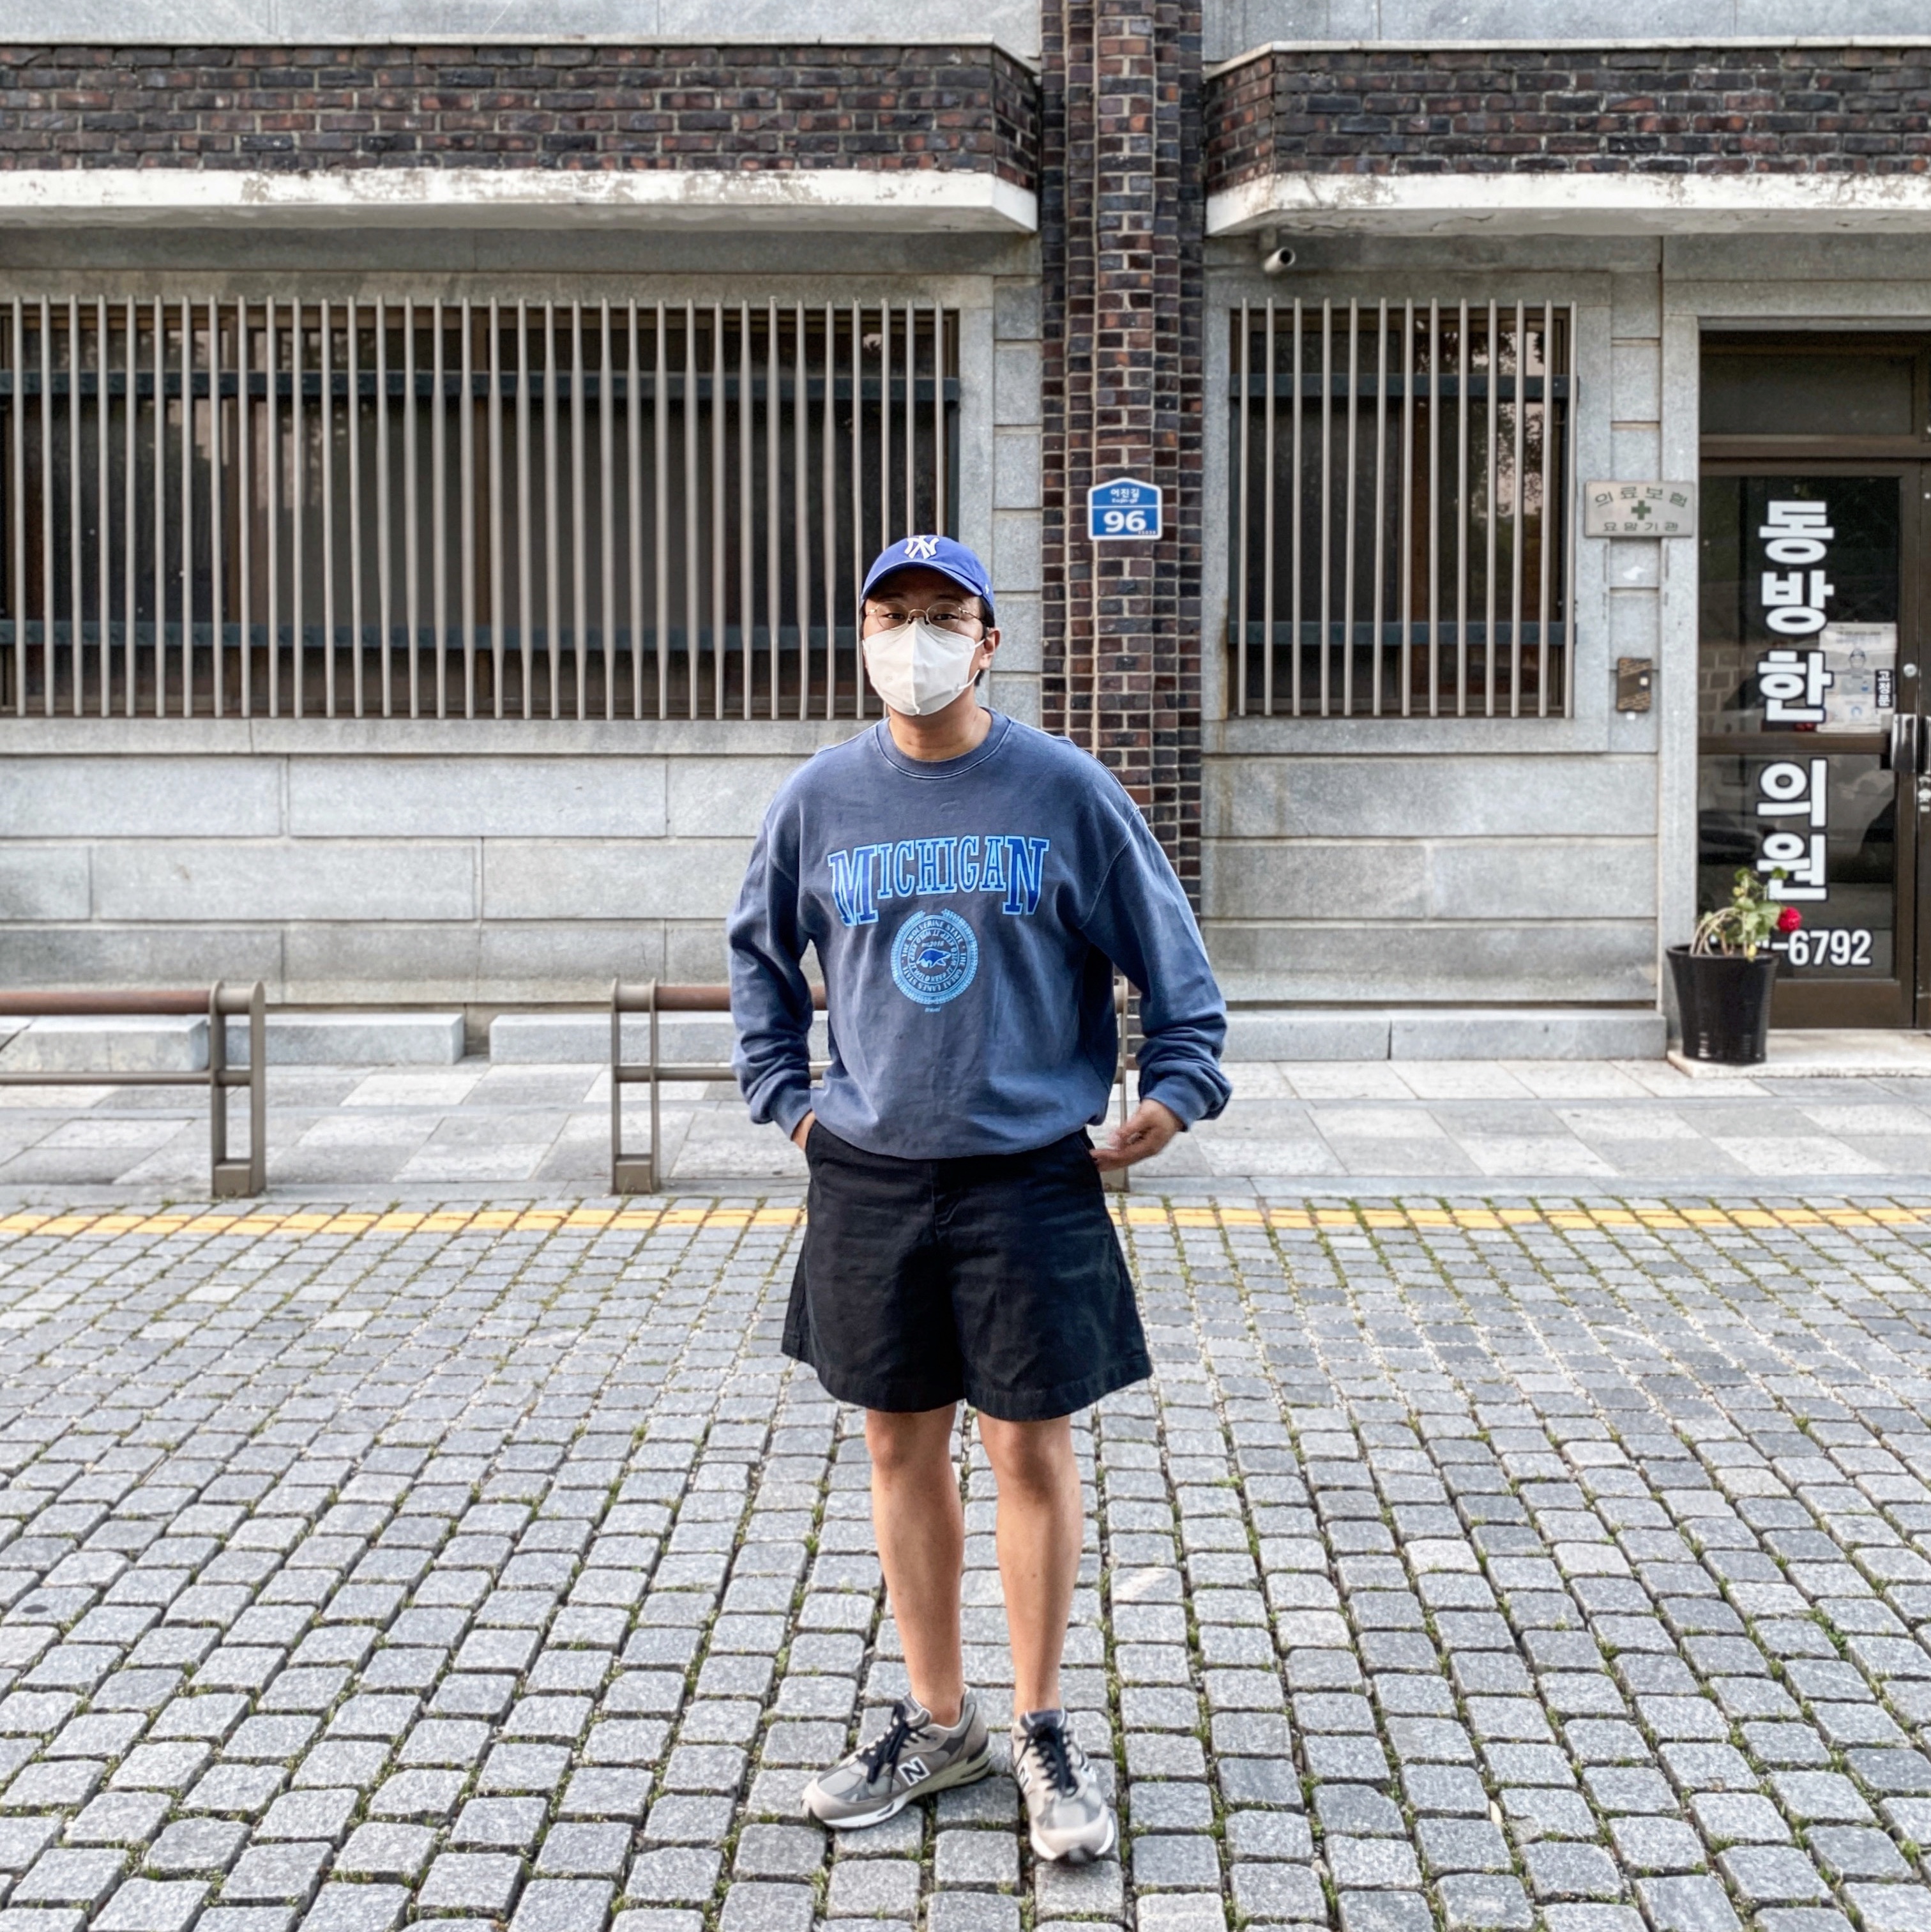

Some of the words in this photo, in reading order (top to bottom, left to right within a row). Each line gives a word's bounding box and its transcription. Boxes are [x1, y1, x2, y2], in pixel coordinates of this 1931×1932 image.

[1110, 488, 1140, 498] 어진길
[1594, 486, 1688, 508] 의료보험
[1103, 510, 1147, 533] 96
[1758, 500, 1835, 901] 동방한의원
[828, 835, 1050, 927] MICHIGAN
[907, 920, 944, 941] WOLVERINE
[945, 922, 964, 944] STATE
[1709, 929, 1872, 965] -6792
[897, 1756, 930, 1786] N
